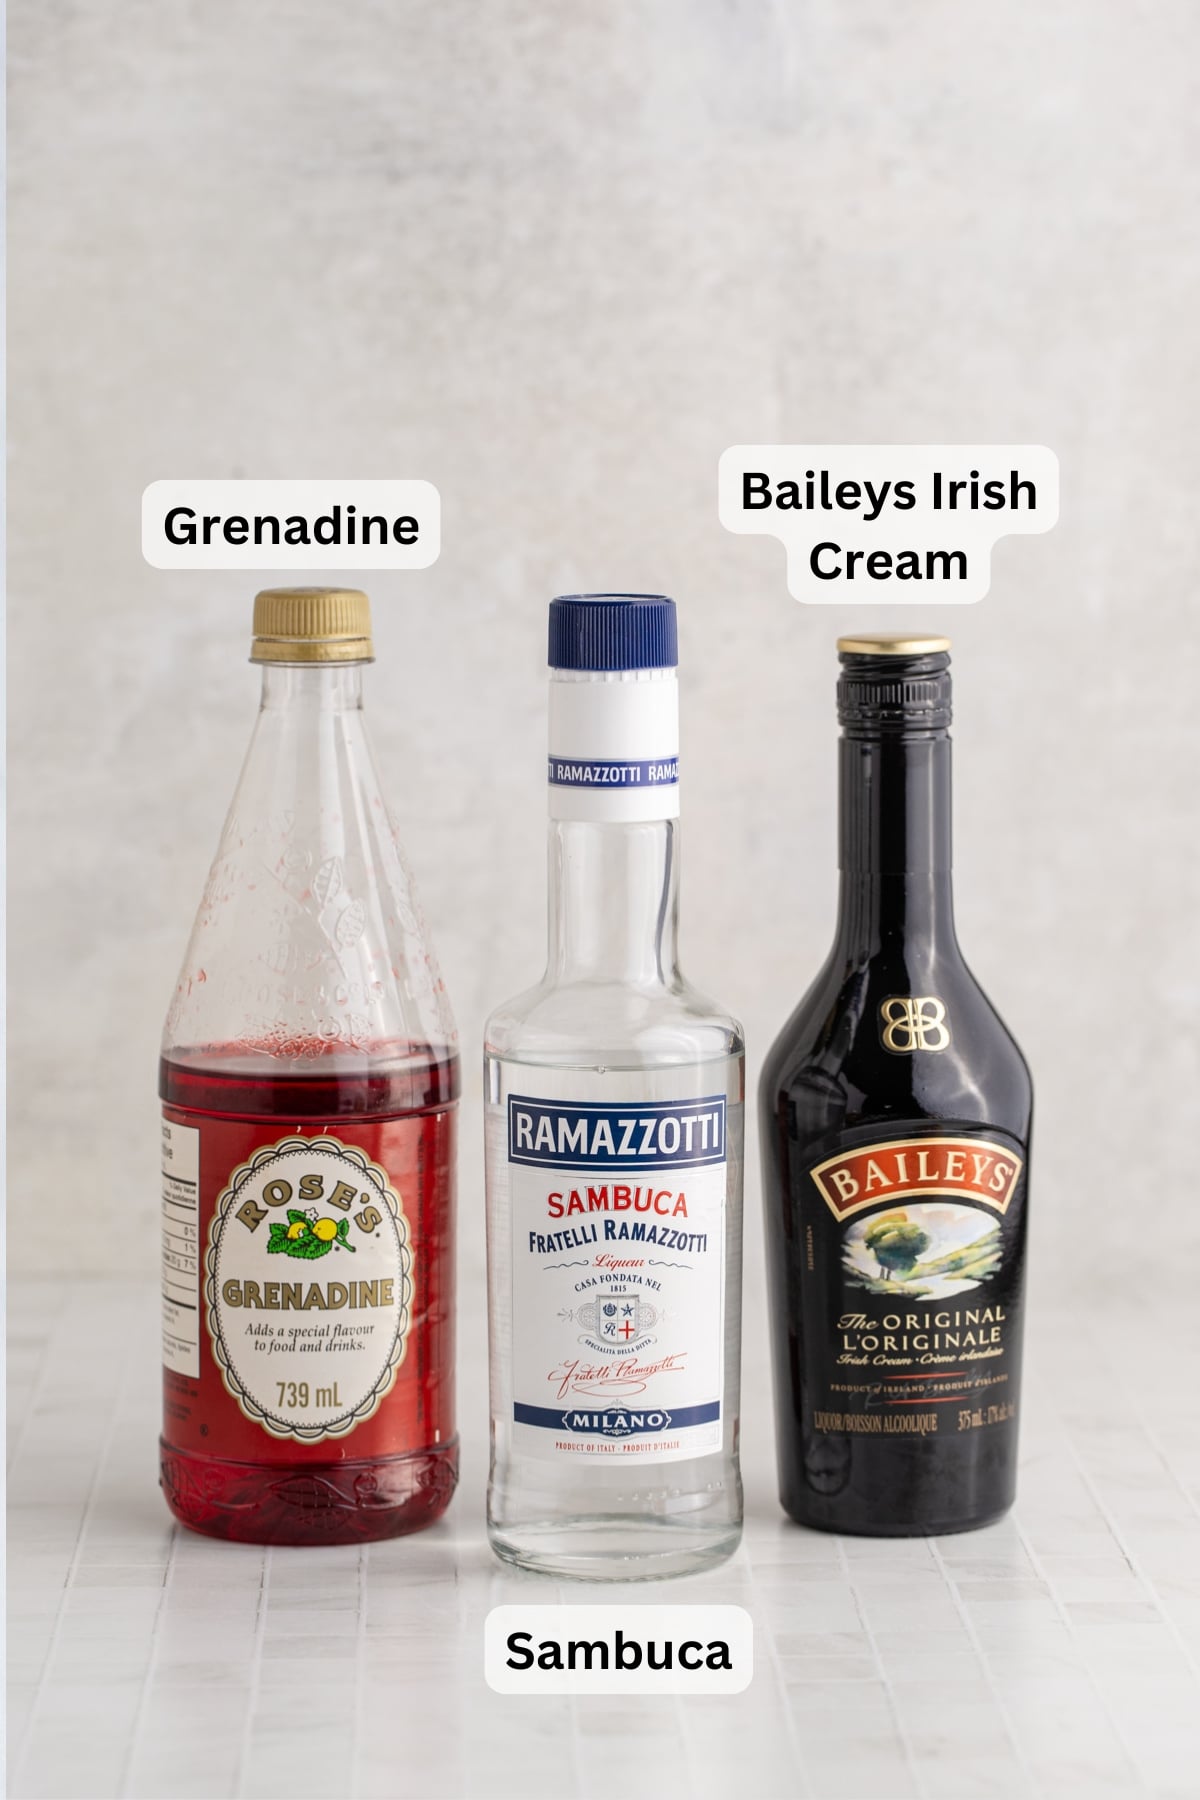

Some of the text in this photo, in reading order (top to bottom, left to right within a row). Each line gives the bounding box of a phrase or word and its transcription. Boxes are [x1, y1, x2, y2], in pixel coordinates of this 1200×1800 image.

[557, 764, 641, 783] RAMAZZOTTI
[516, 1112, 719, 1155] RAMAZZOTTI
[829, 1151, 1008, 1201] BAILEYS
[235, 1174, 383, 1234] ROSE'S
[547, 1184, 689, 1218] SAMBUCA
[592, 1254, 646, 1271] Liqueur
[574, 1273, 662, 1292] CASA FONDATA NEL
[610, 1284, 627, 1293] 1815
[222, 1279, 395, 1311] GRENADINE
[837, 1305, 1006, 1331] The ORIGINAL
[245, 1323, 375, 1341] Adds a special flavour
[843, 1326, 1002, 1351] L'ORIGINALE
[254, 1338, 366, 1355] to food and drinks.
[836, 1353, 870, 1366] Irish
[872, 1353, 913, 1366] Cream
[919, 1350, 957, 1364] Crème
[276, 1382, 343, 1408] 739 mL
[830, 1384, 871, 1393] PRODUCT
[883, 1384, 926, 1393] IRELAND
[573, 1413, 665, 1428] MILANO
[883, 1413, 938, 1436] ALCOOLIQUE
[555, 1440, 680, 1452] PRODUCT OF ITALY PRODUIT D'ITALIE
